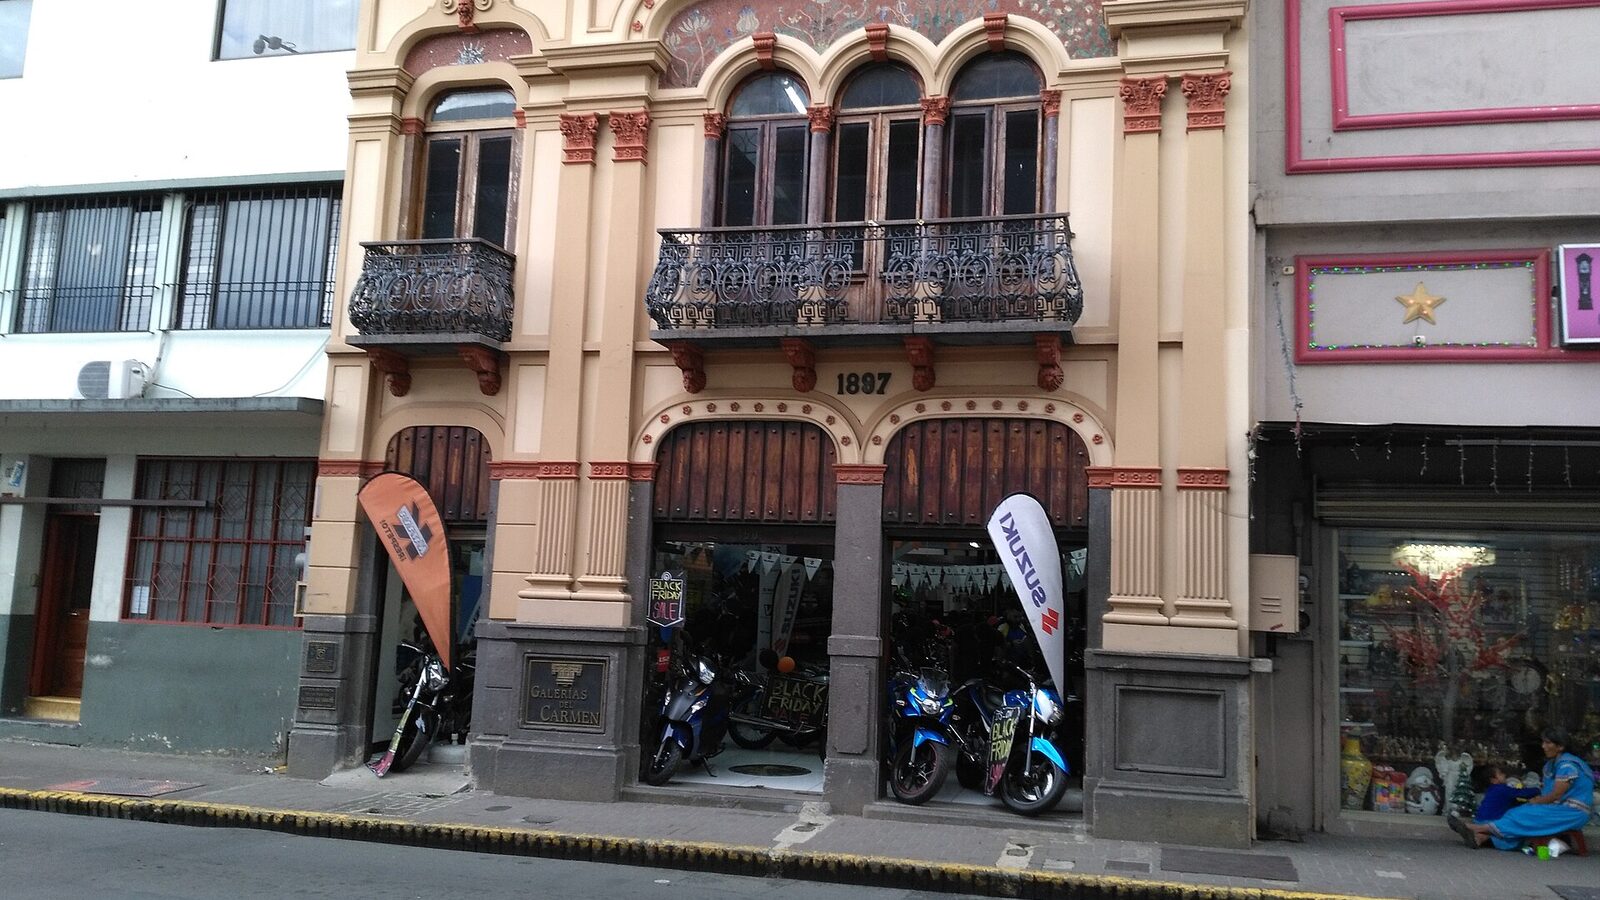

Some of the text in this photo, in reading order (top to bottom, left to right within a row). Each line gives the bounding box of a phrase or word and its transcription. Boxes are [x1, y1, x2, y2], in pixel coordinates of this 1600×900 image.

[837, 372, 892, 395] 1897
[651, 580, 682, 591] BLACK
[651, 590, 682, 600] FRIDAY
[781, 568, 801, 634] SUZUKI
[652, 602, 679, 620] SALE
[772, 680, 826, 703] BLACK
[540, 704, 600, 724] CARMEN
[560, 701, 574, 709] DEL
[767, 696, 822, 715] FRIDAY
